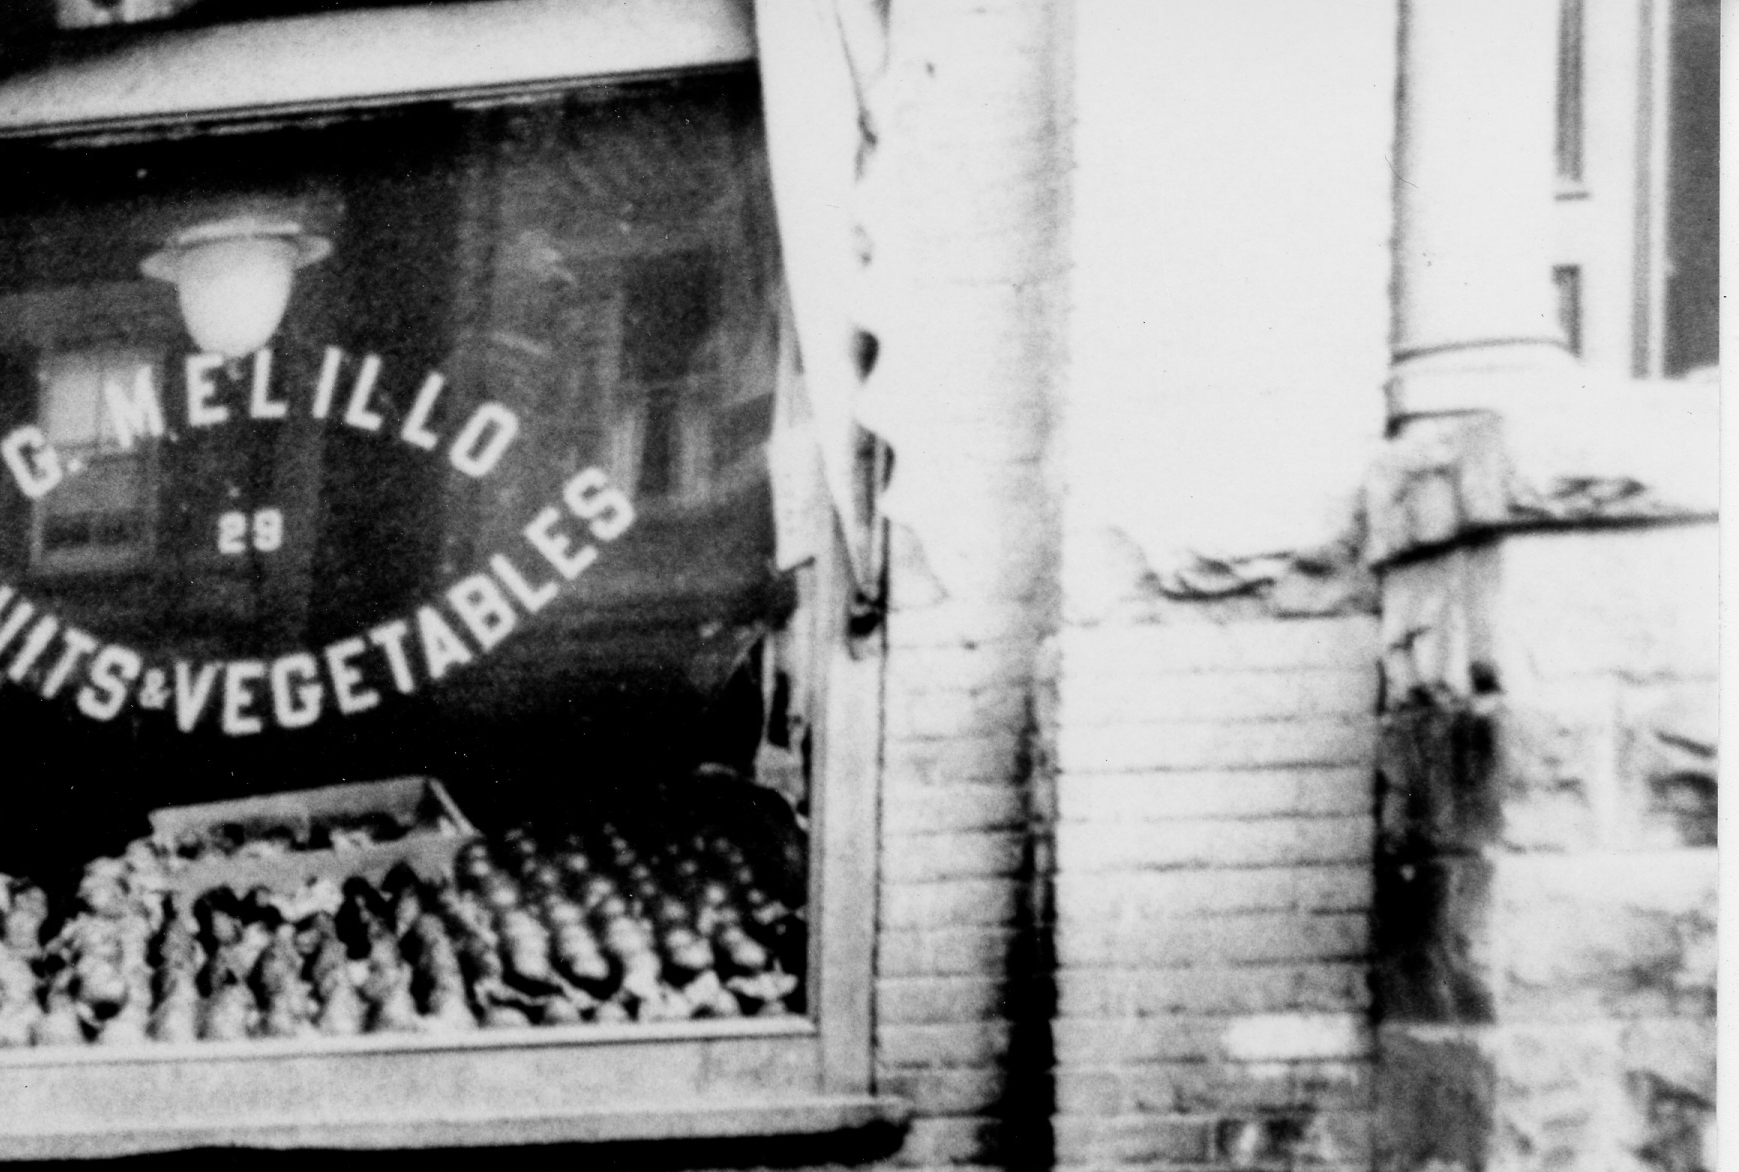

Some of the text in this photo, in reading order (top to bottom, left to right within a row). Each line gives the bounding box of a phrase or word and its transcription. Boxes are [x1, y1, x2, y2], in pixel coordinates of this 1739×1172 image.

[102, 345, 521, 480] MELILLO
[217, 508, 284, 555] 29
[173, 466, 638, 736] VEGETABLES
